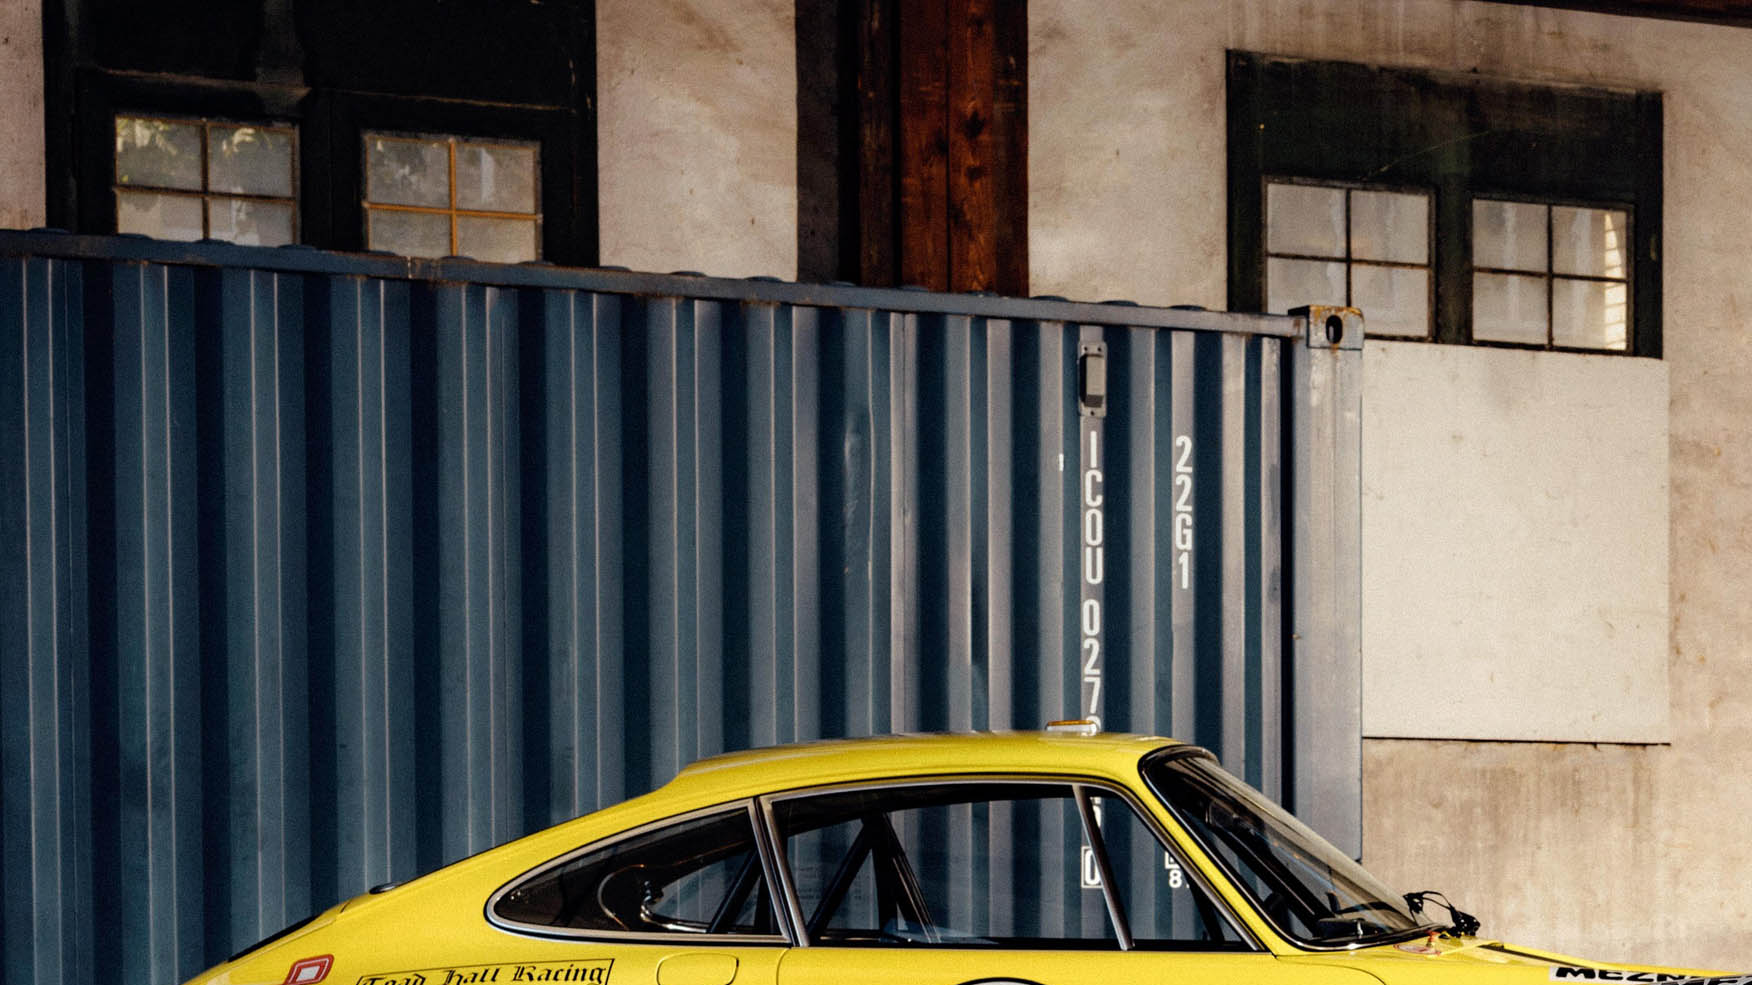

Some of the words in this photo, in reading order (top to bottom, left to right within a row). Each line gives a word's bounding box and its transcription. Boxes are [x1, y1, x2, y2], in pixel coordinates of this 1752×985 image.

[1084, 430, 1103, 585] ICOU
[1175, 435, 1193, 590] 22G1
[512, 963, 607, 985] Racing
